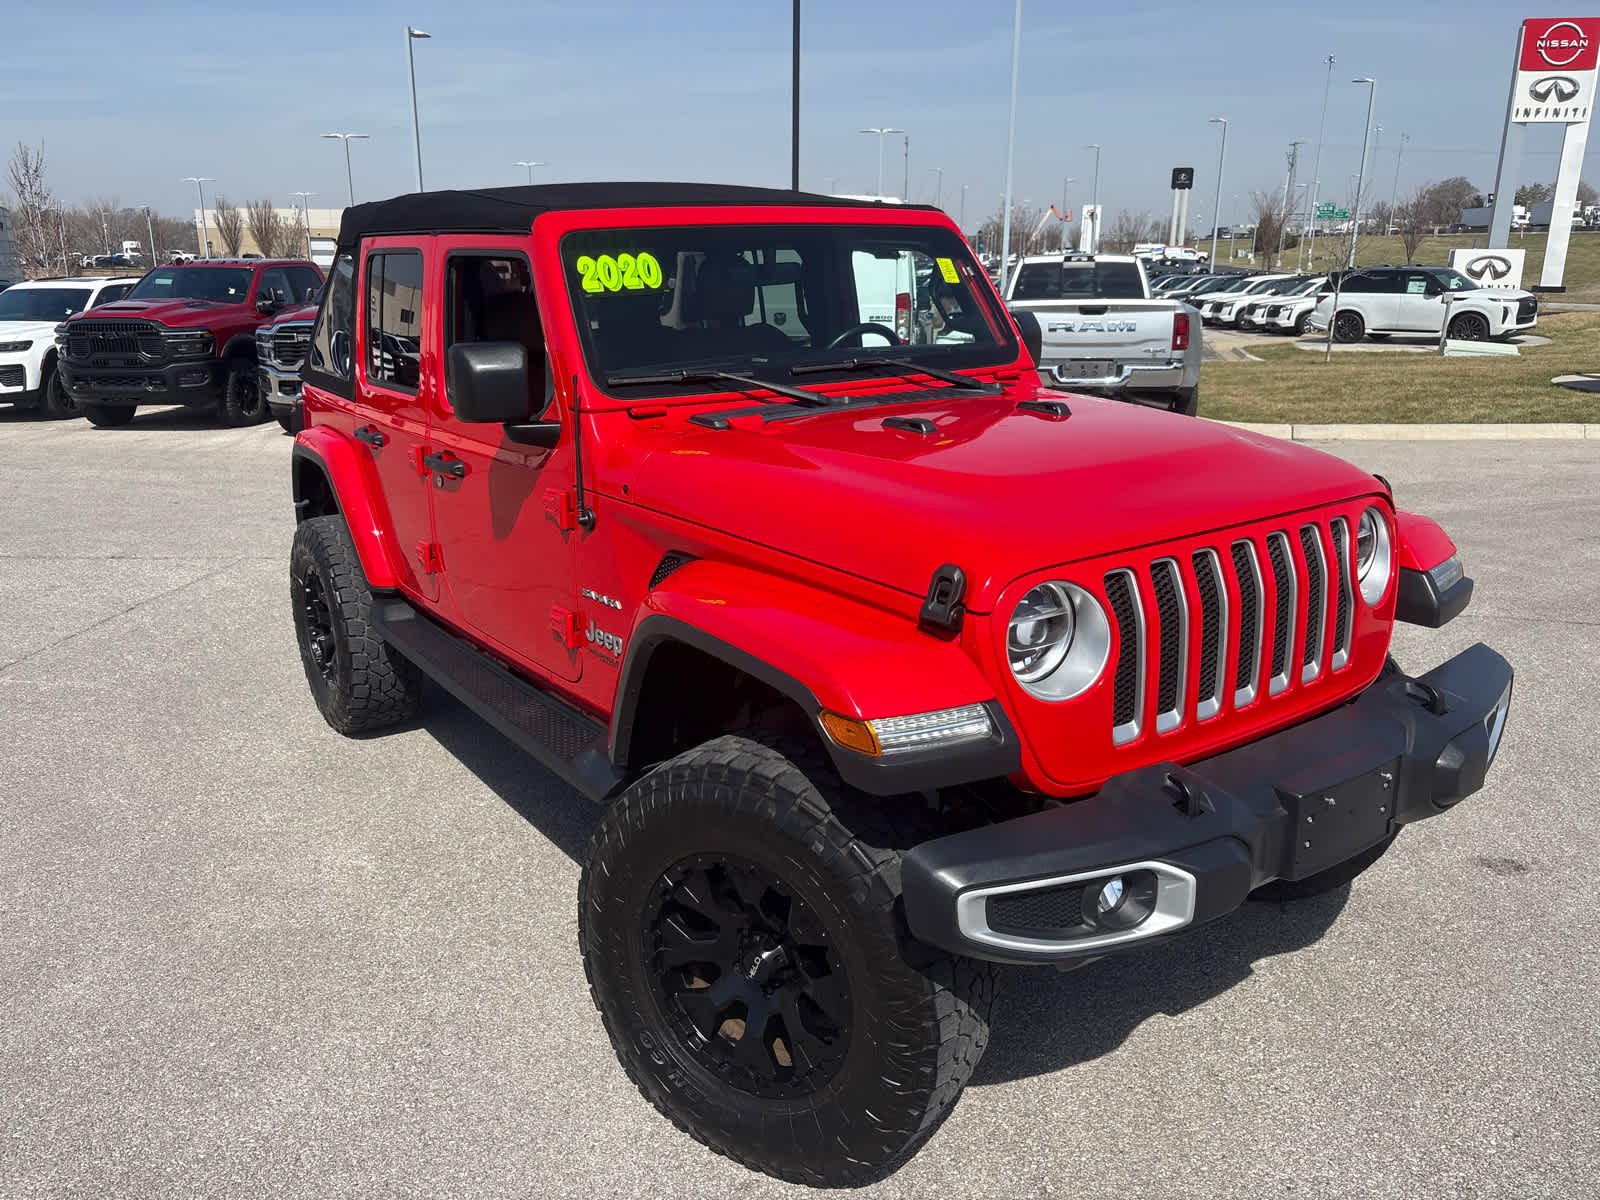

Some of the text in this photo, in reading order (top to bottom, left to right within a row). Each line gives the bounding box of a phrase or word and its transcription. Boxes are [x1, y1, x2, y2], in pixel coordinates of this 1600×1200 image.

[1536, 39, 1589, 49] NISSAN
[1514, 107, 1588, 119] INFINITI
[576, 252, 663, 293] 2020
[1047, 320, 1137, 333] RAM
[585, 619, 624, 657] Jeep
